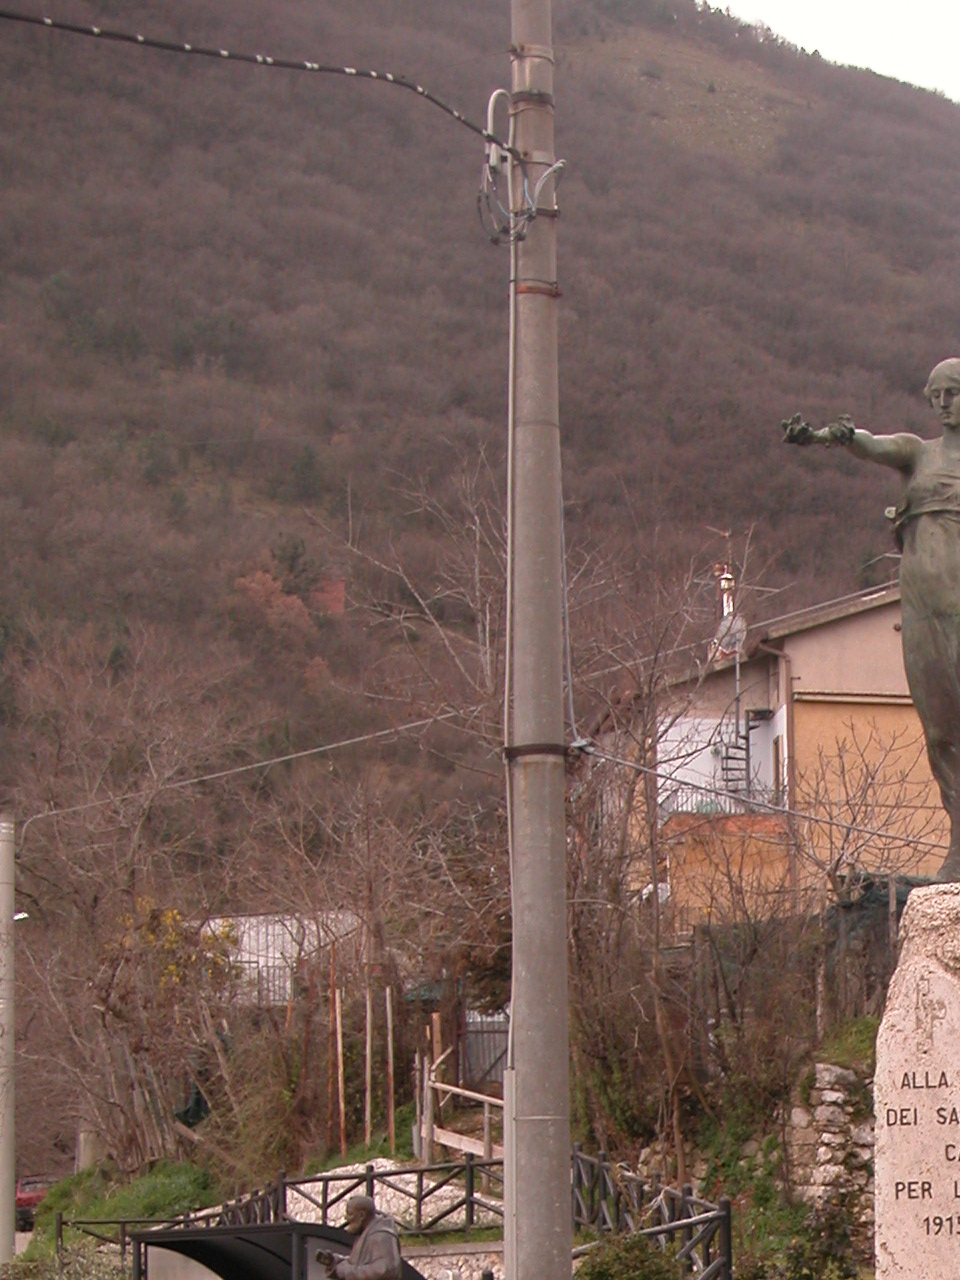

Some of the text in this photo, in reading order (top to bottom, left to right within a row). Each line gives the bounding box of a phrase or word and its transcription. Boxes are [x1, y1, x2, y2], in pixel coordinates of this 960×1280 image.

[901, 1071, 949, 1089] ALLA
[886, 1108, 918, 1127] DEI
[895, 1181, 933, 1200] PER
